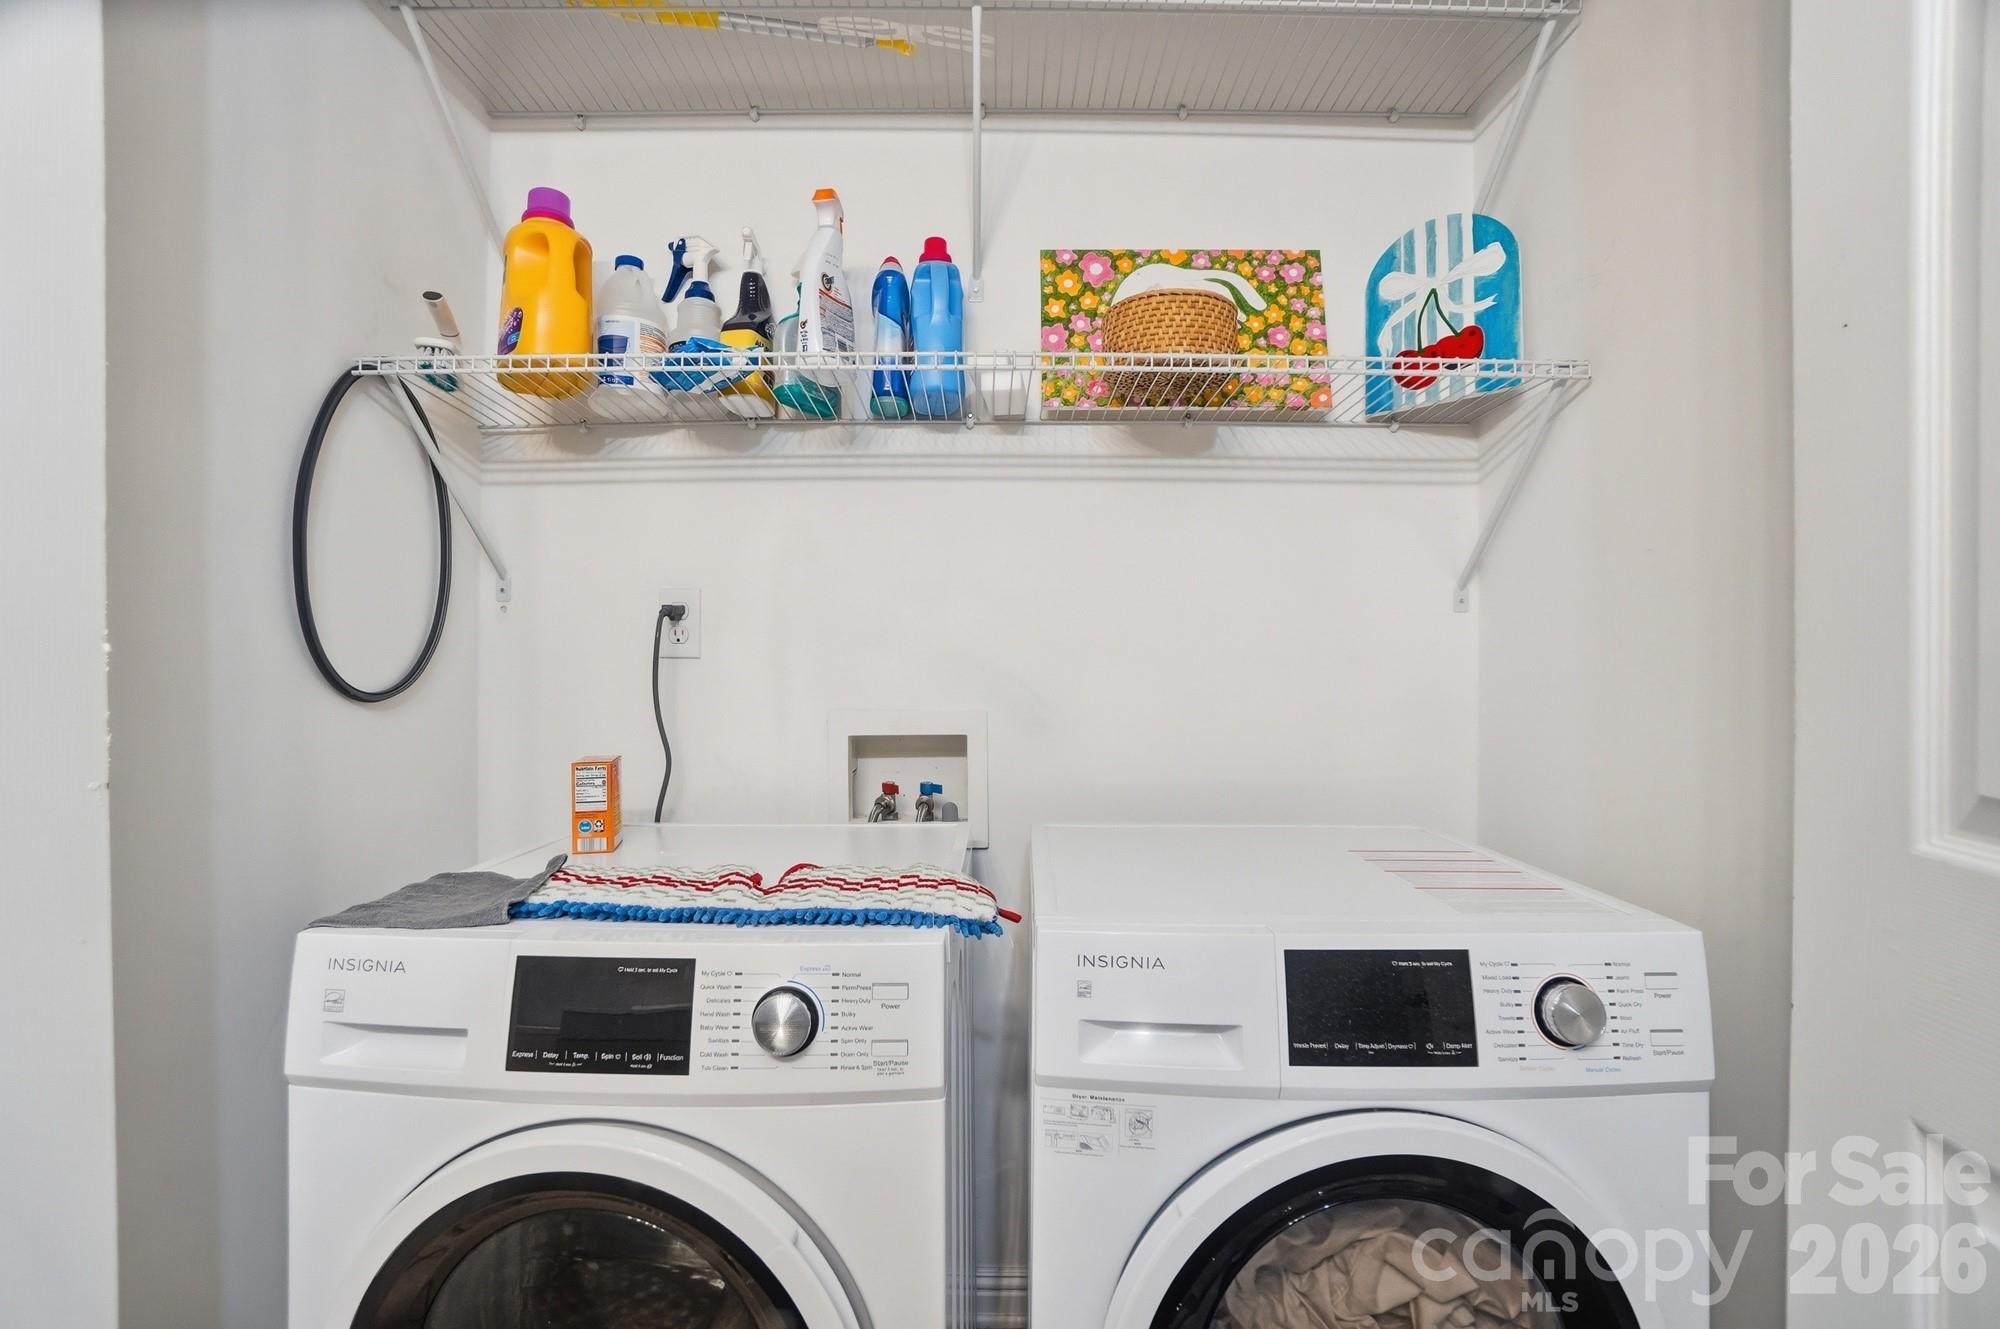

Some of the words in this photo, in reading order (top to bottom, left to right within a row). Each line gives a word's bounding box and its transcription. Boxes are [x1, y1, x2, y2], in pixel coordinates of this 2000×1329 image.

[328, 957, 406, 973] INSIGNIA
[1077, 954, 1165, 970] INSIGNIA
[1334, 1042, 1350, 1050] Delay
[512, 1050, 534, 1058] Express
